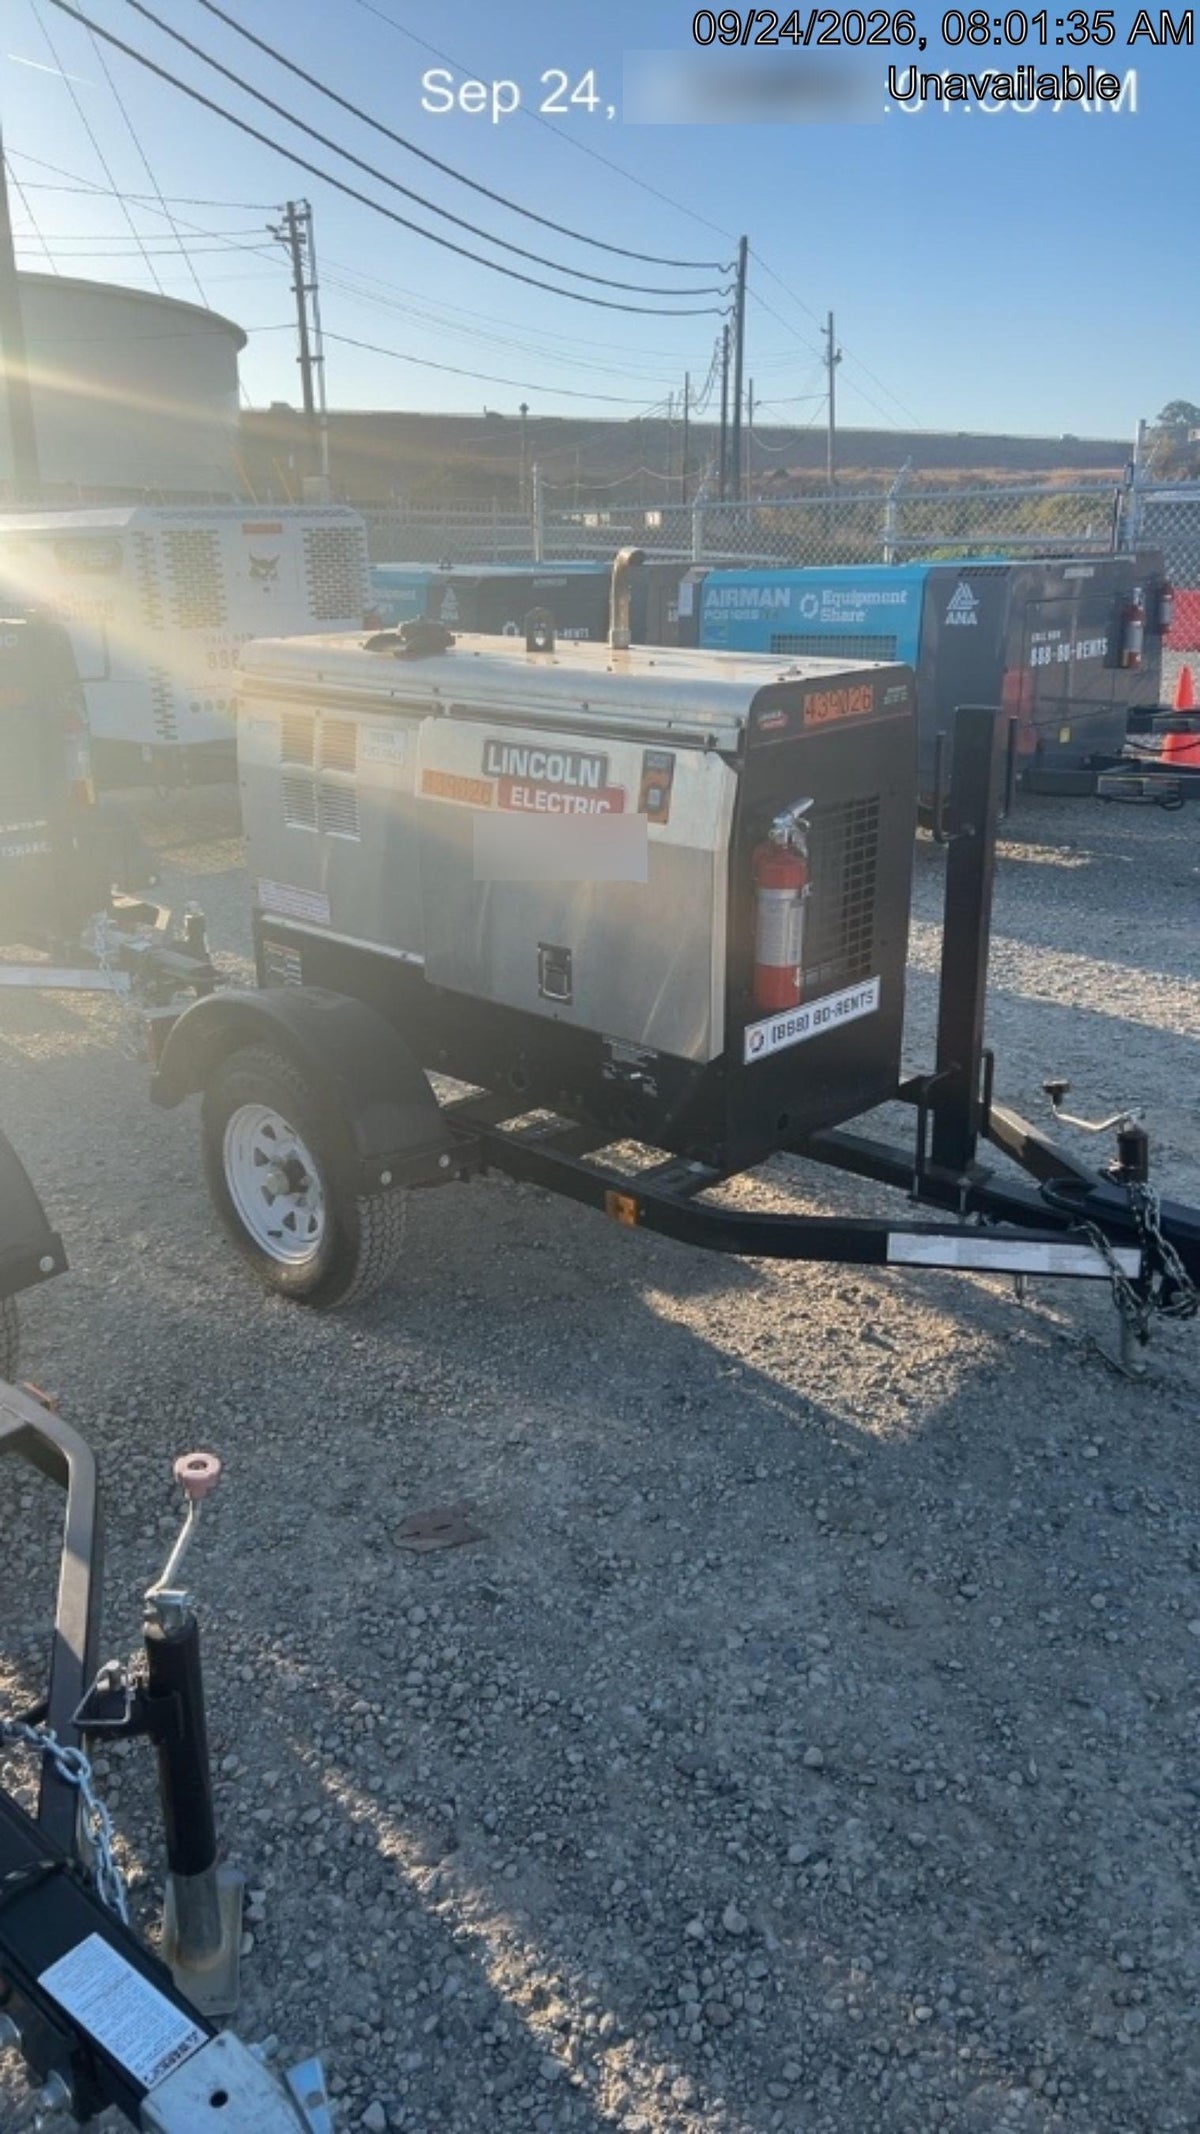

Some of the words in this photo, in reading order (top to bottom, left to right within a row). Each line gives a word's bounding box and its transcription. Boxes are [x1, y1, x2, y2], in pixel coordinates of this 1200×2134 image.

[704, 587, 790, 607] AIRMAN
[822, 589, 908, 607] Equipment
[820, 608, 866, 622] Share
[945, 611, 978, 626] ANA
[487, 745, 603, 789] LINCOLN
[510, 785, 611, 815] ELECTRIC
[813, 989, 874, 1025] 80-RENTS
